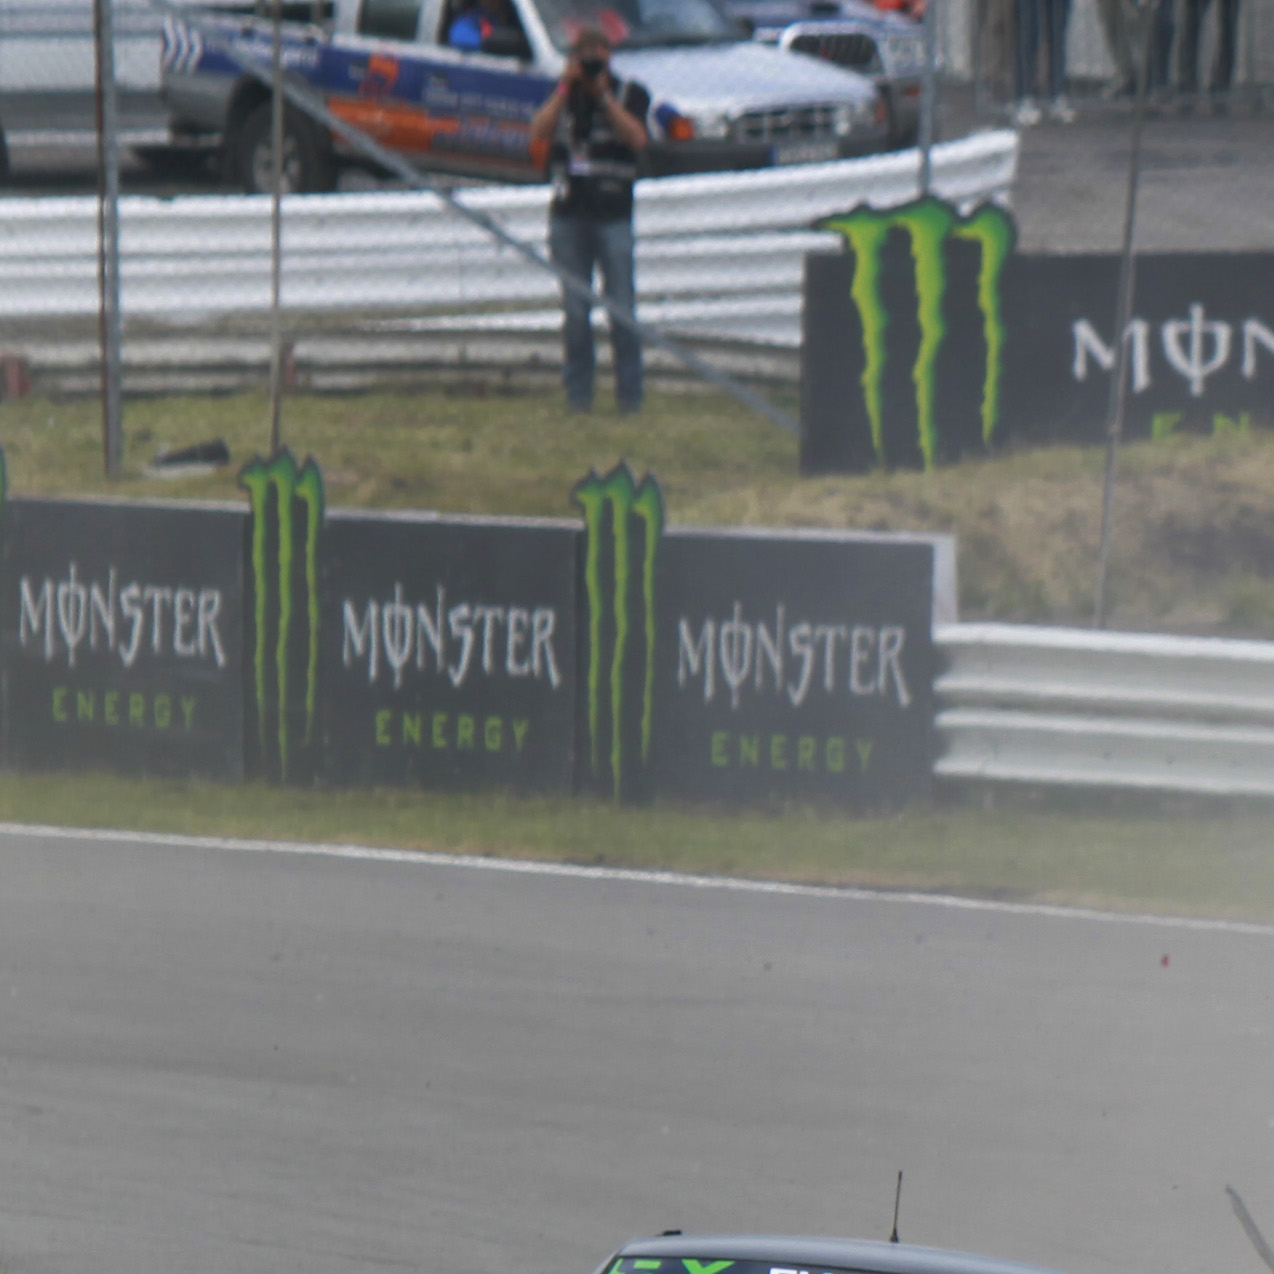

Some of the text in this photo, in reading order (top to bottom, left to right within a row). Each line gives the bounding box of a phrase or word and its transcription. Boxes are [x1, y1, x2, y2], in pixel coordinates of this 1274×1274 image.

[19, 562, 227, 668] MONSTER
[342, 582, 562, 690] MONSTER
[677, 600, 912, 711] MONSTER
[52, 686, 197, 731] ENERGY
[375, 708, 530, 752] ENERGY
[711, 731, 874, 774] ENERGY
